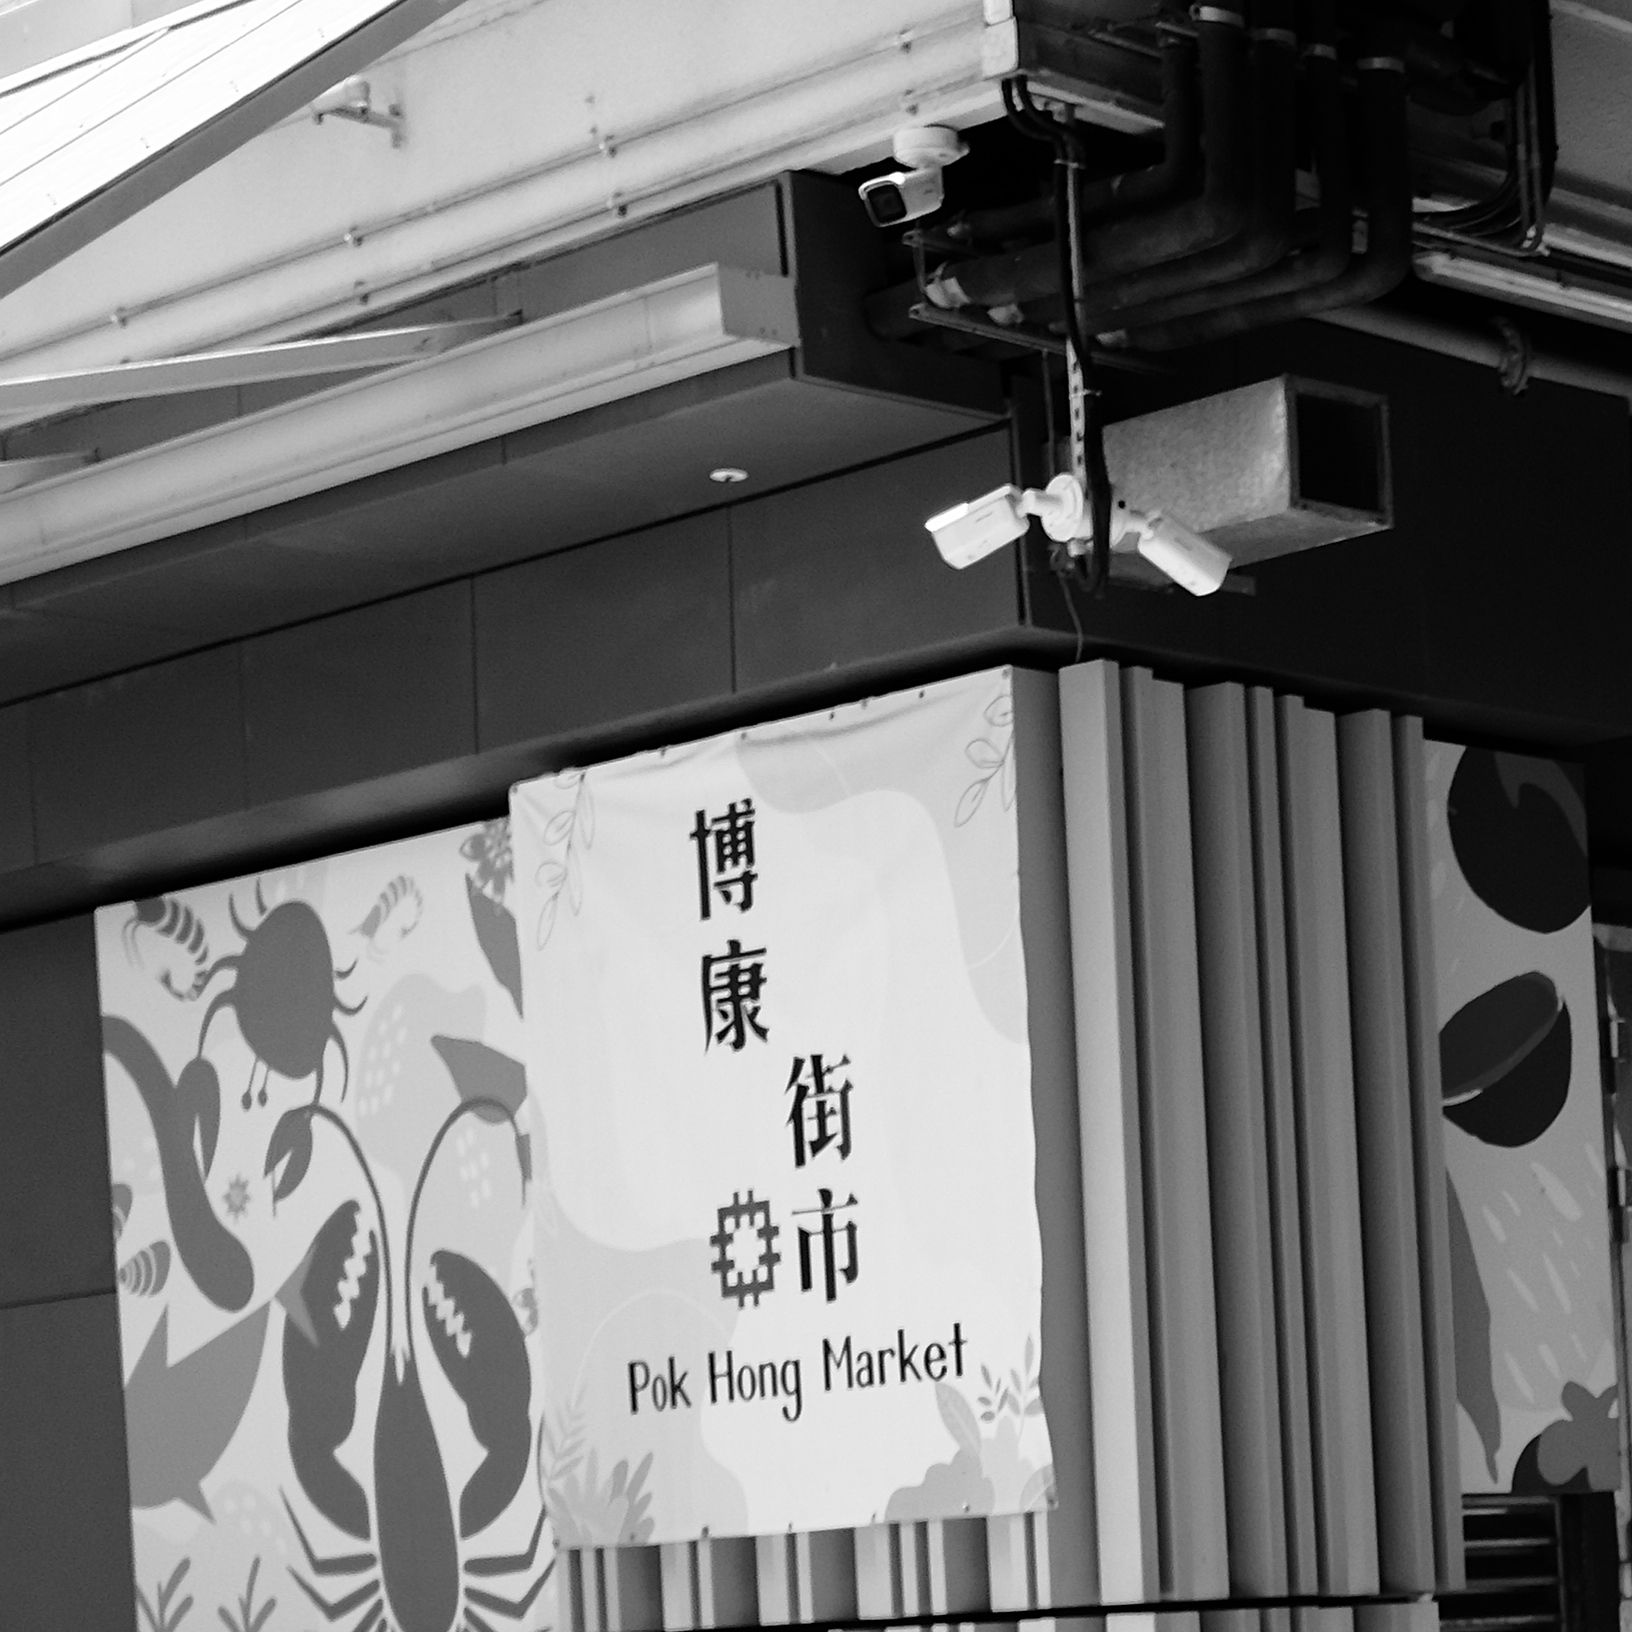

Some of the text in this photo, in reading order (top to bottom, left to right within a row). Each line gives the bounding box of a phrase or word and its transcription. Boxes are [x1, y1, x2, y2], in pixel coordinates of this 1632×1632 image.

[627, 1323, 967, 1422] Pok Hong Market
